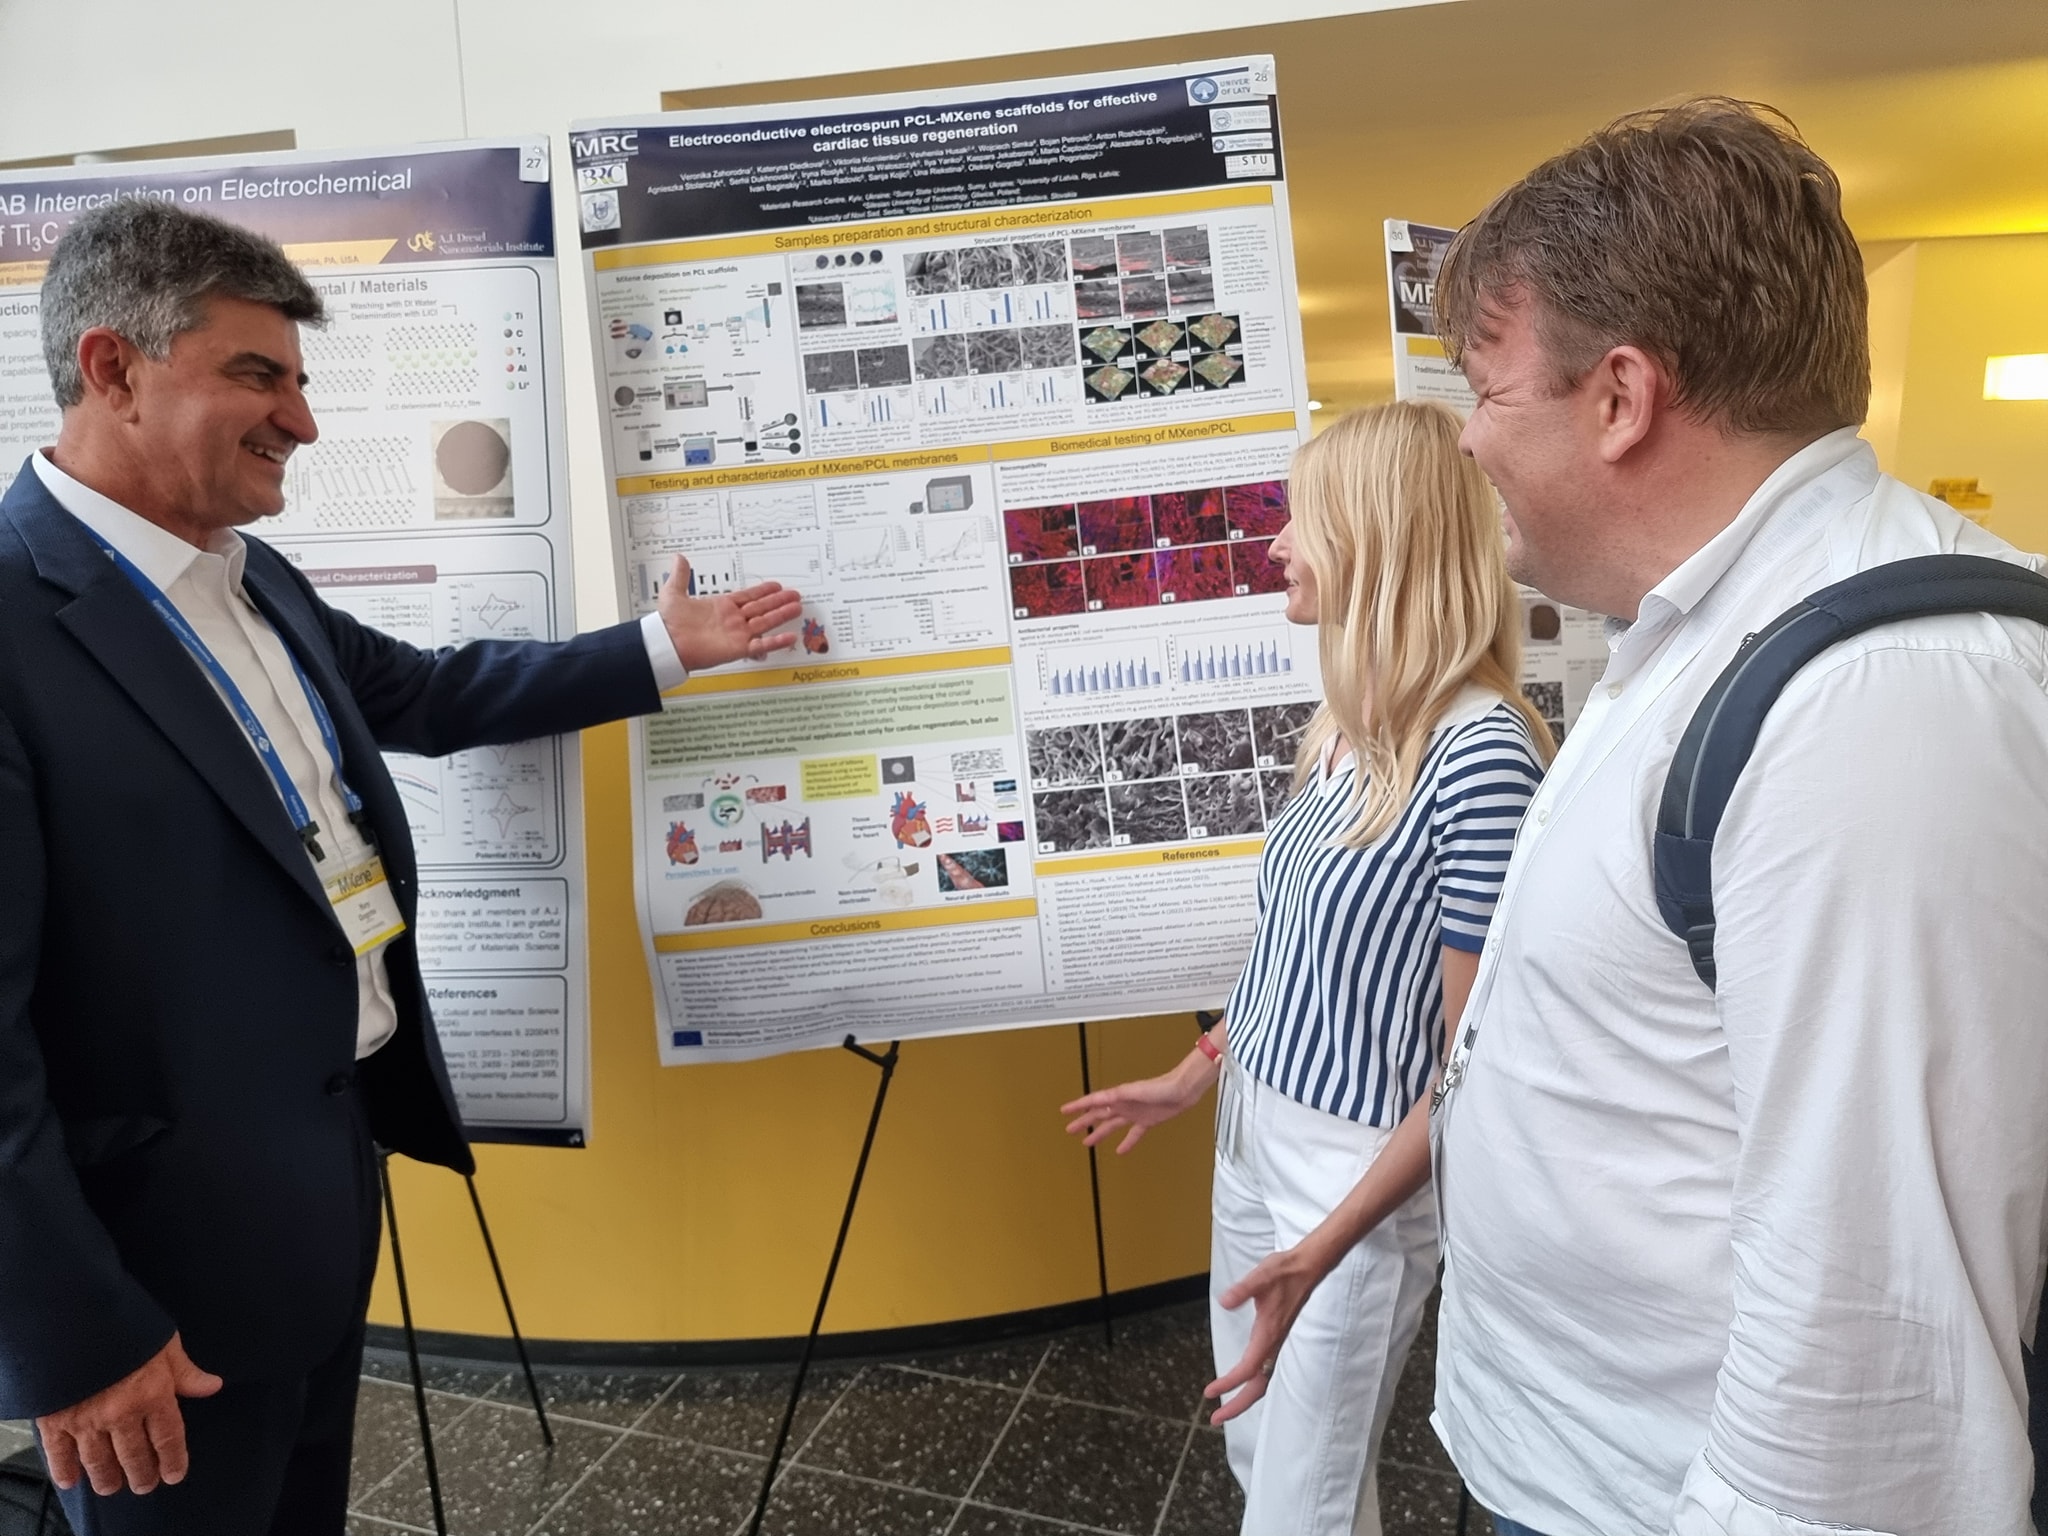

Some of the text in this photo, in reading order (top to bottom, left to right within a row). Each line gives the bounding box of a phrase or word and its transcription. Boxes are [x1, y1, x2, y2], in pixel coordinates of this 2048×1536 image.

[1220, 78, 1250, 87] UNIVER
[1254, 72, 1268, 82] 28
[1232, 86, 1251, 94] LATV
[669, 90, 1157, 148] Electroconductive electrospun PCL-MXene scaffolds for effective
[812, 123, 1018, 152] cardiac tissue regeneration
[1095, 132, 1116, 140] Anton
[575, 134, 638, 158] MRC
[1109, 138, 1145, 148] Alexander
[526, 158, 542, 169] 27
[182, 186, 211, 203] on
[220, 168, 411, 200] Electrochemical
[774, 207, 1091, 248] Samples preparation and structural characterization
[1010, 231, 1046, 242] properties
[1098, 224, 1135, 232] membrane
[1391, 232, 1403, 240] 30
[505, 241, 544, 251] Institute
[642, 271, 680, 281] deposition
[706, 266, 738, 274] scaffolds
[360, 278, 428, 294] Materials
[516, 329, 523, 337] C
[1050, 421, 1235, 452] Biomedical testing of MXene/PCL
[650, 452, 957, 490] Testing and characterization of MXene/PCL membranes
[334, 570, 418, 583] Characterization
[791, 666, 859, 683] Applications
[865, 687, 896, 697] providing
[899, 682, 936, 691] mechanical
[938, 680, 964, 689] support
[871, 696, 897, 704] thereby
[899, 693, 933, 701] mimicking
[923, 700, 959, 710] deposition
[961, 698, 978, 706] using
[741, 737, 773, 748] potential
[786, 734, 811, 742] clinical
[813, 730, 852, 740] application
[867, 727, 882, 735] only
[922, 720, 968, 730] regeneration,
[1263, 757, 1269, 765] d
[852, 823, 886, 832] engineering
[862, 830, 879, 838] heart
[1162, 849, 1220, 861] References
[416, 888, 520, 900] Acknowledgment
[966, 892, 982, 900] guide
[810, 919, 881, 935] Conclusions
[428, 988, 498, 999] References
